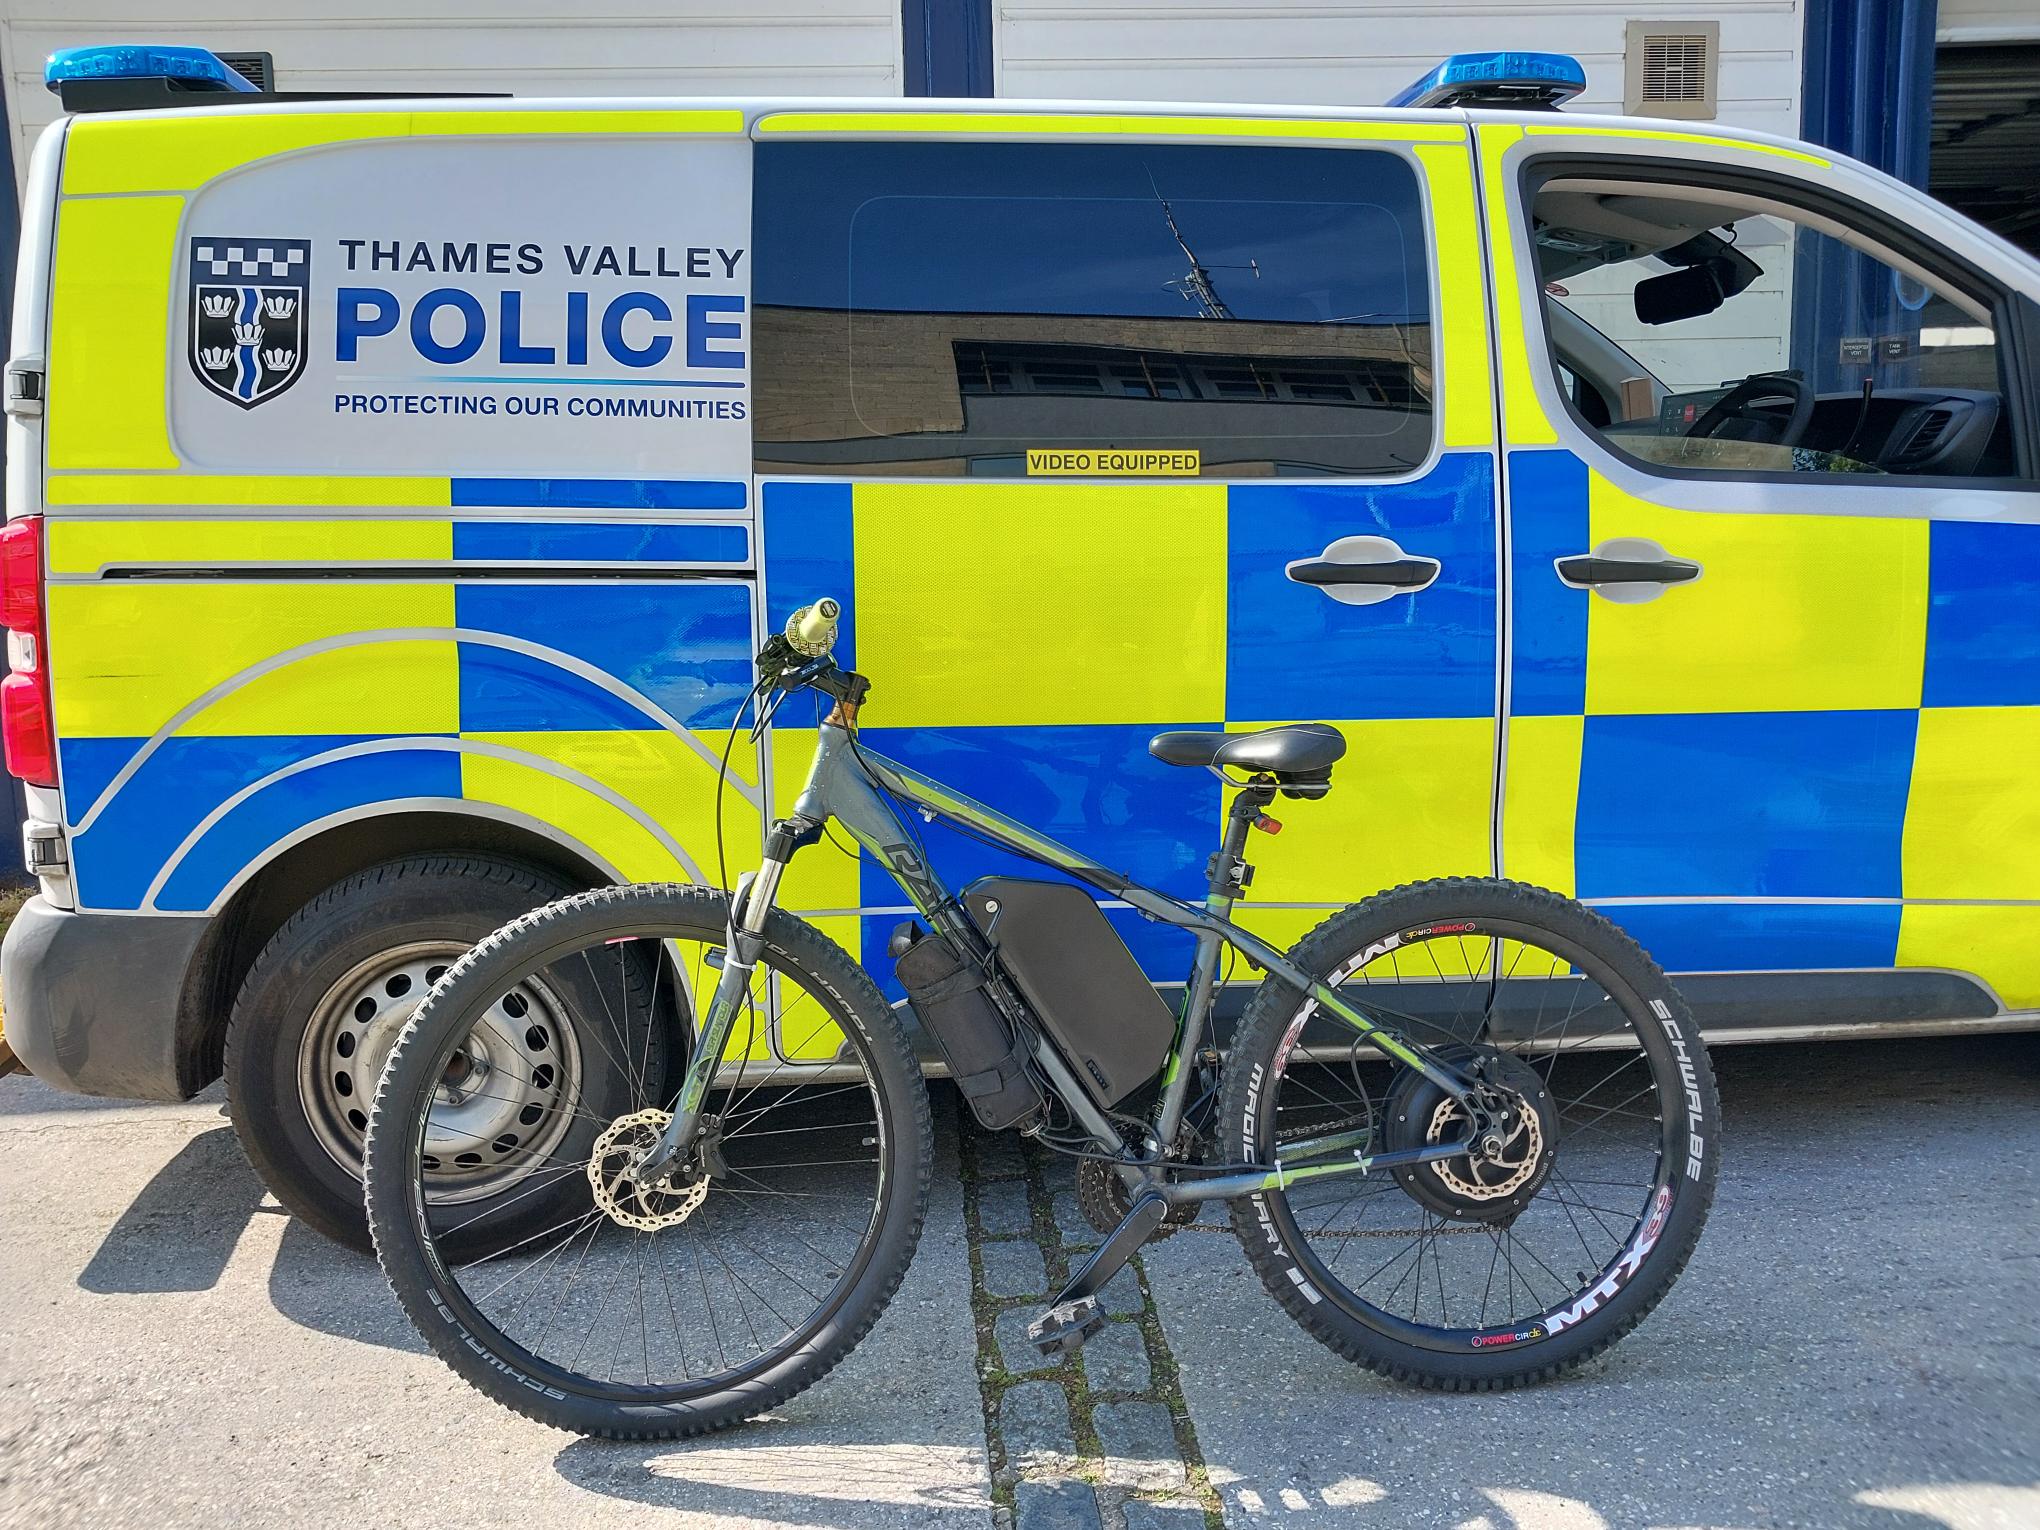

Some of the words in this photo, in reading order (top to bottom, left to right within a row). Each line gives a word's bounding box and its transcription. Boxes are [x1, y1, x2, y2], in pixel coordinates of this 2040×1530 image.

[339, 239, 543, 275] THAMES
[563, 245, 745, 278] VALLEY
[336, 287, 746, 369] POLICE
[335, 395, 497, 417] PROTECTING
[504, 396, 559, 417] OUR
[567, 397, 746, 420] COMMUNITIES
[1030, 454, 1091, 471] VIDEO
[1097, 454, 1198, 471] EQUIPPED
[766, 941, 800, 966] TO
[810, 971, 873, 1046] TOUGH
[1242, 1063, 1264, 1164] MAGIC
[1649, 999, 1704, 1182] SCHWALBE
[1545, 1232, 1658, 1337] MTX
[426, 1288, 568, 1401] SCHWALBE
